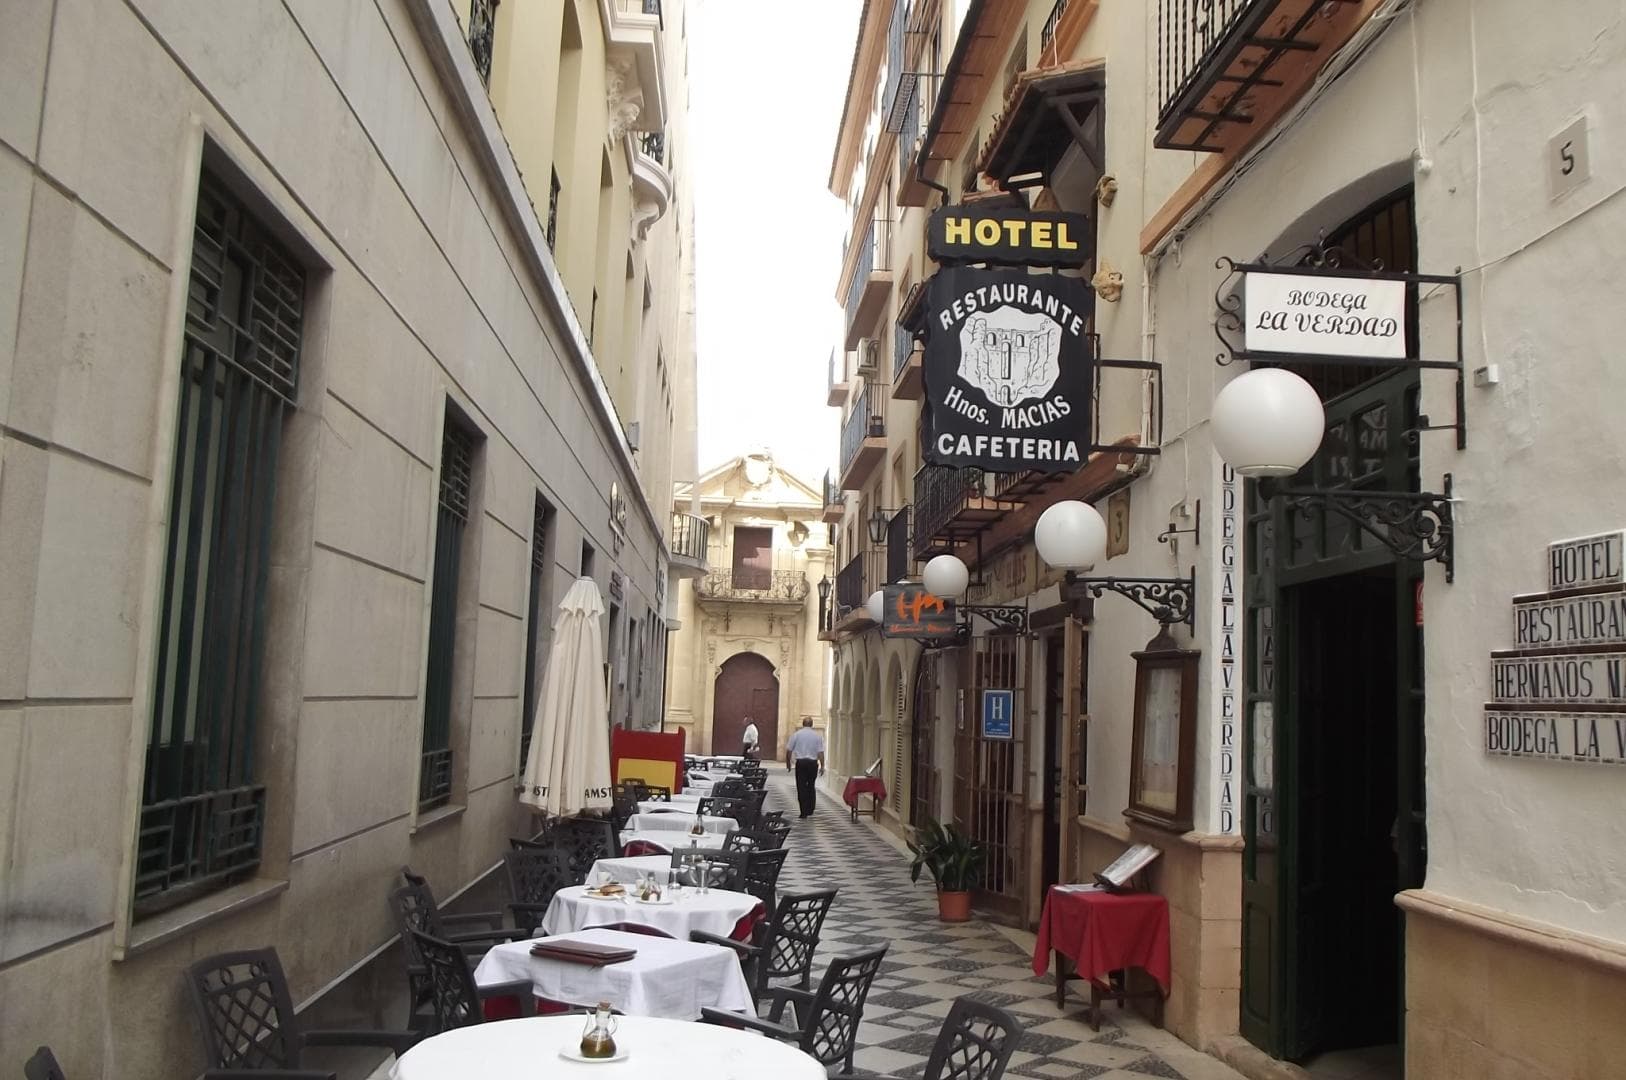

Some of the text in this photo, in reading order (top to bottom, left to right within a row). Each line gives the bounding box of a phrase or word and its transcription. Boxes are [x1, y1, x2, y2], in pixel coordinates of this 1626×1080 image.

[1560, 140, 1574, 176] 5
[945, 217, 1078, 250] HOTEL
[938, 283, 1084, 337] RESTAURANTE
[1287, 289, 1368, 314] BODEGA
[1256, 311, 1398, 338] LA VERDAD
[944, 385, 1072, 430] Hnos. MACIAS
[937, 433, 1080, 462] CAFETERIA
[1222, 462, 1234, 594] ODEGA
[1551, 539, 1619, 586] HOTEL
[1494, 660, 1593, 699] HERMANOS
[991, 696, 1004, 720] H
[1221, 667, 1234, 833] VERDAD
[1488, 716, 1560, 755] BODEGA
[1573, 719, 1600, 757] LA
